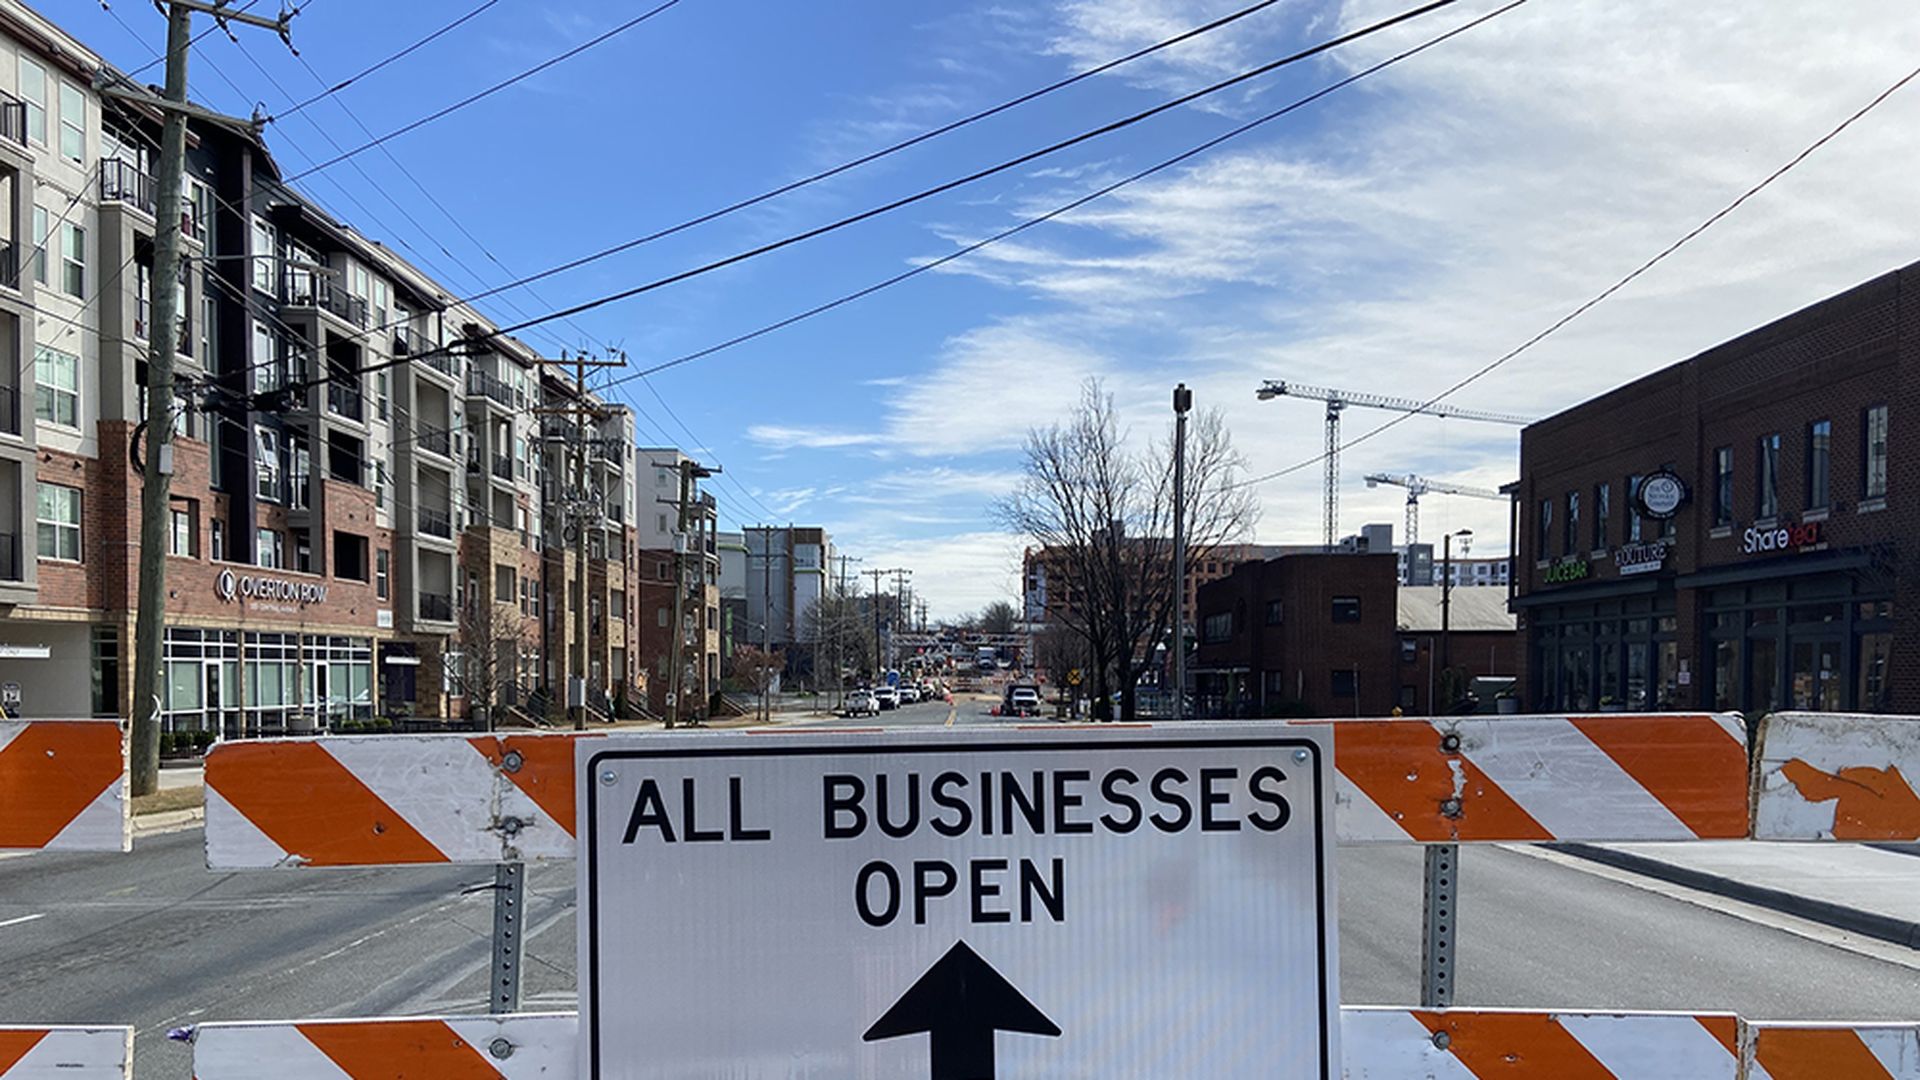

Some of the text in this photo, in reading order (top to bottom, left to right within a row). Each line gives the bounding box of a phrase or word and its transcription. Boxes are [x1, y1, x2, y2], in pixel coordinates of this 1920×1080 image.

[1744, 523, 1817, 554] Sharetea
[240, 576, 329, 602] OVERTON ROW
[623, 766, 1291, 844] ALL BUSINESSES
[855, 858, 1065, 927] OPEN
